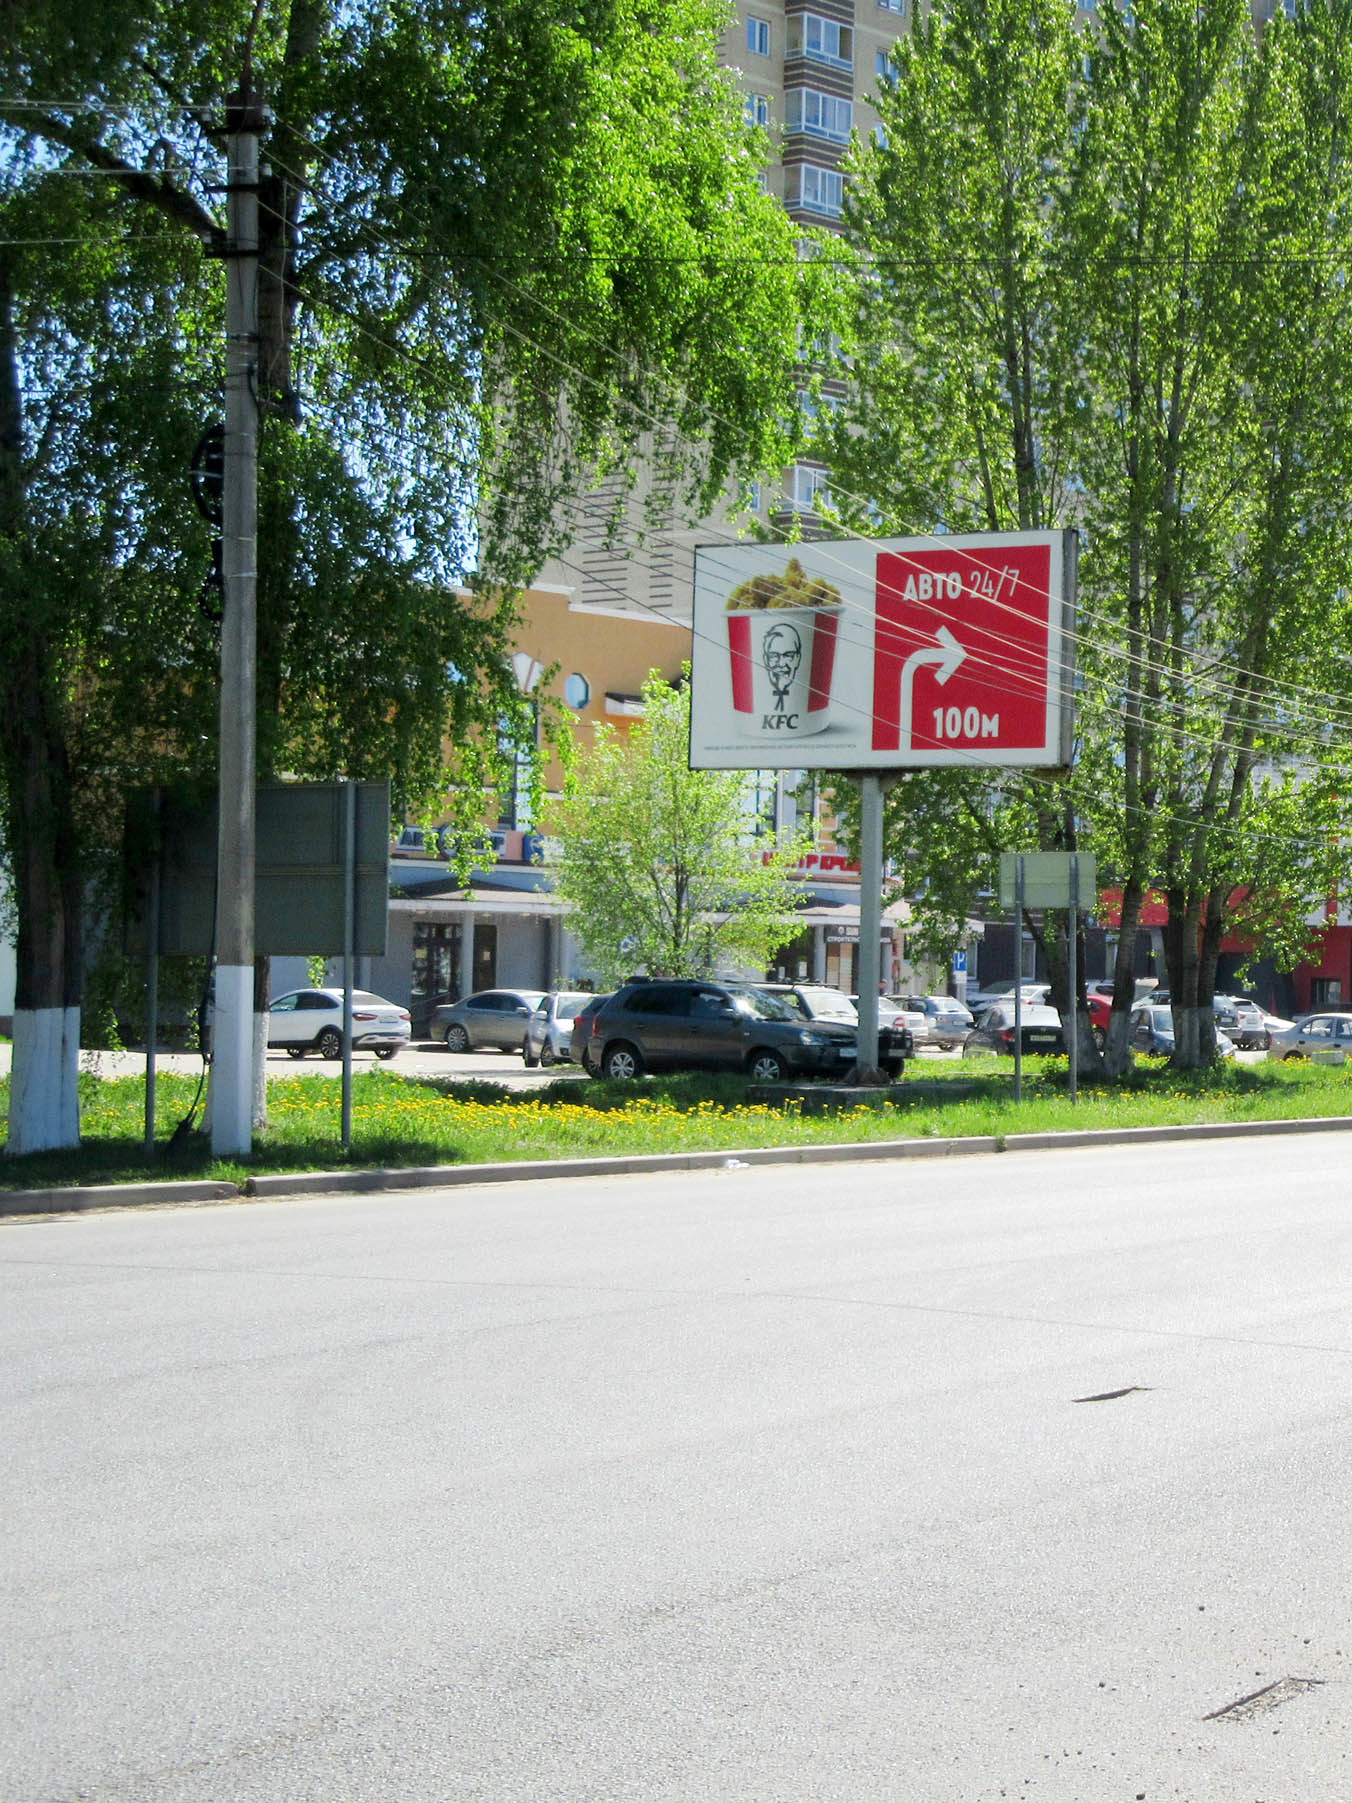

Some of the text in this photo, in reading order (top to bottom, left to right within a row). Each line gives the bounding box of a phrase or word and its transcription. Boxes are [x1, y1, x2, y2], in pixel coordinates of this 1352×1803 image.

[903, 565, 1020, 601] АВТО 24/7
[761, 713, 800, 730] KFC
